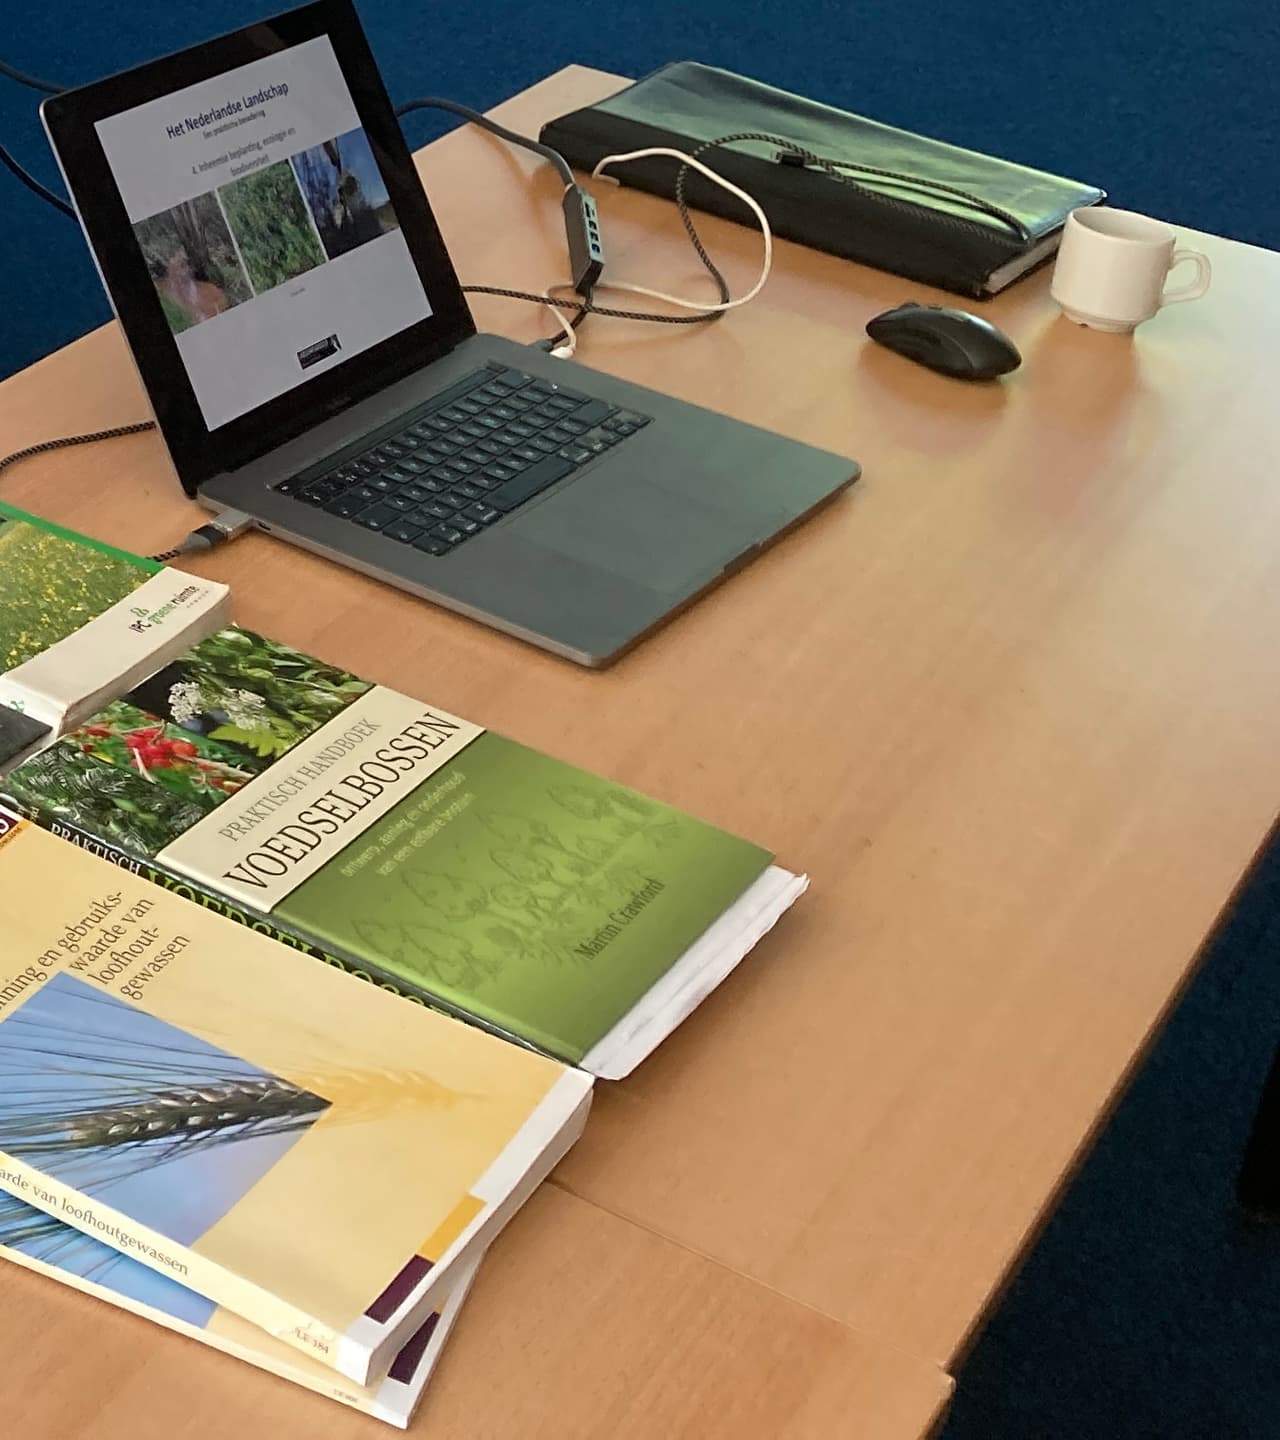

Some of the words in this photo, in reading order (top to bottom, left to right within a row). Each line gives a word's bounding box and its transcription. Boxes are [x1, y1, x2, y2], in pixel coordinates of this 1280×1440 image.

[166, 121, 186, 140] Het
[185, 100, 242, 131] Nederlandse
[242, 82, 289, 110] Landschap
[218, 776, 304, 842] PRAKTISCH
[304, 717, 382, 782] HANDBOEK
[222, 711, 461, 890] VOEDSELBOSSEN
[50, 822, 141, 876] PRAKTISCH
[38, 948, 63, 967] en
[57, 889, 124, 954] gebruiks-
[69, 921, 127, 974] waarde
[121, 897, 155, 926] van
[86, 925, 161, 986] loofhout-
[573, 923, 622, 961] Martin
[608, 877, 665, 926] Crawford
[120, 934, 191, 1001] gewassen
[32, 1184, 58, 1207] van
[61, 1196, 189, 1277] loofhoutgewassen
